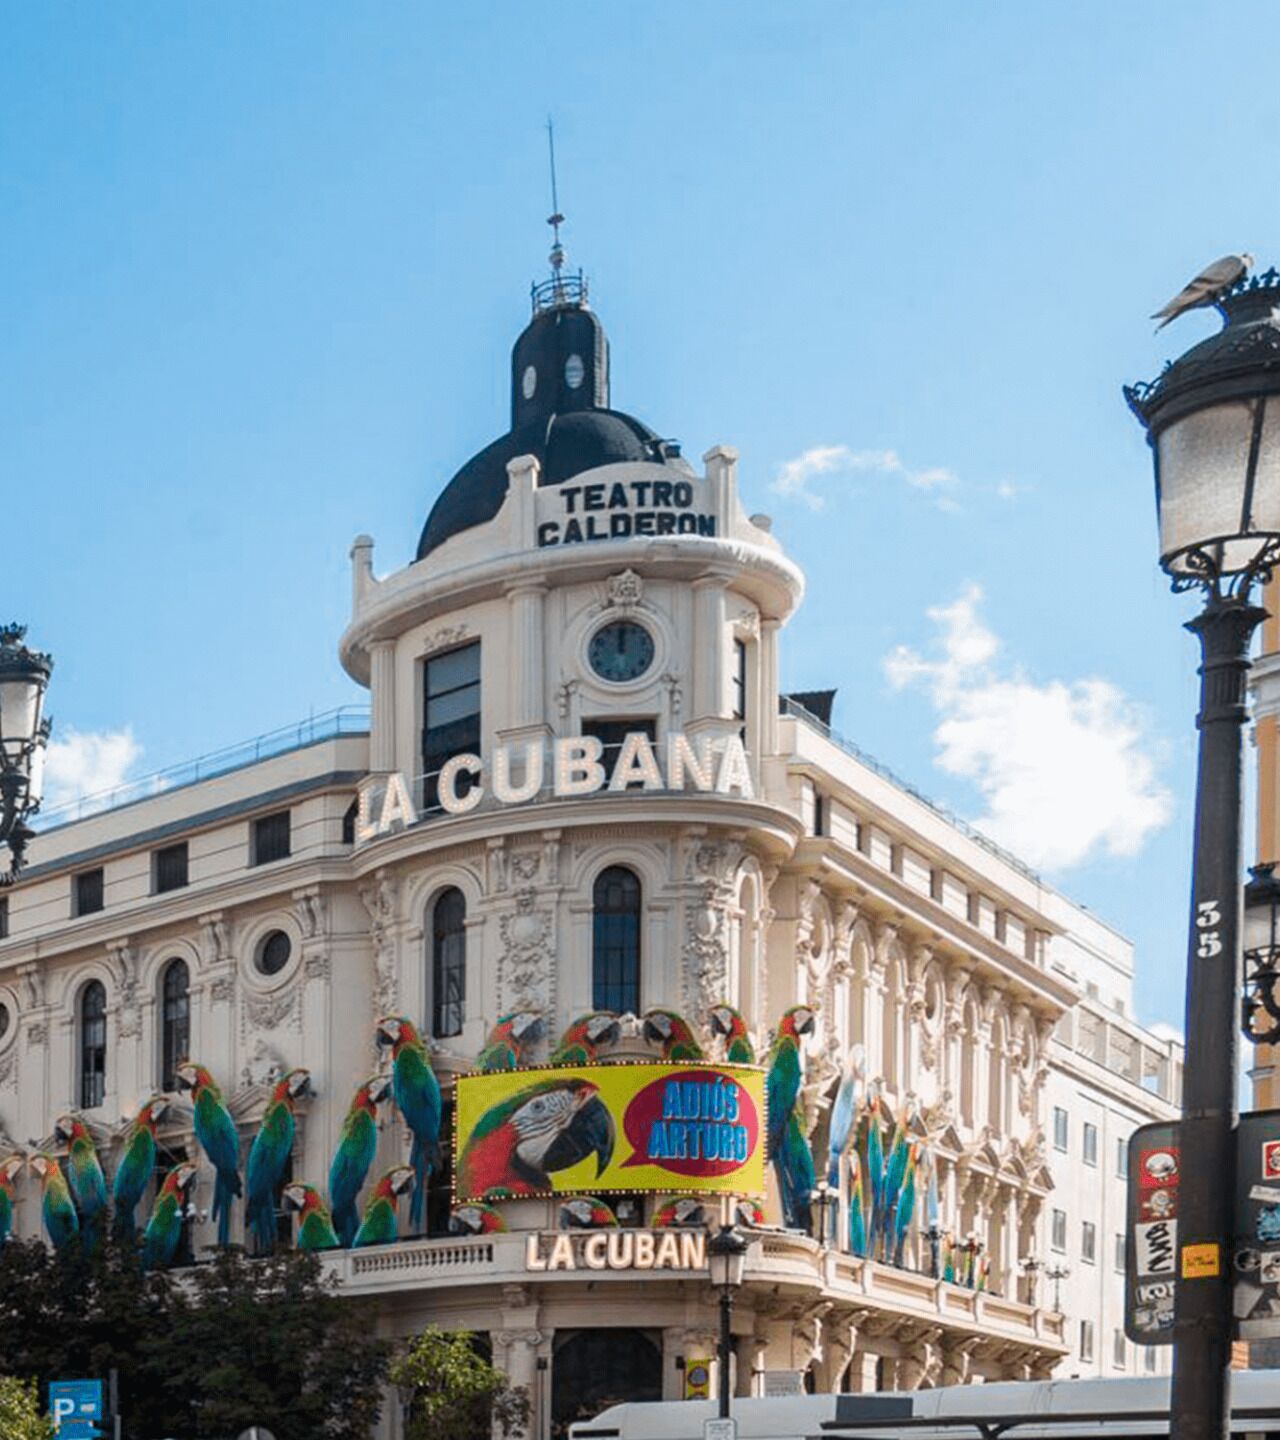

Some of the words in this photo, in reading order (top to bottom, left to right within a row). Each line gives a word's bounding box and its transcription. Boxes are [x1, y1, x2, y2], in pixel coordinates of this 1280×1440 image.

[559, 480, 694, 515] TEATRO
[537, 510, 717, 548] CALDERON
[357, 772, 418, 842] LA
[437, 732, 756, 814] CUBANA
[662, 1077, 740, 1122] ADIÓS
[647, 1120, 748, 1162] ARTURO
[526, 1230, 576, 1271] LA
[584, 1231, 710, 1271] CUBAN
[54, 1398, 75, 1428] P
